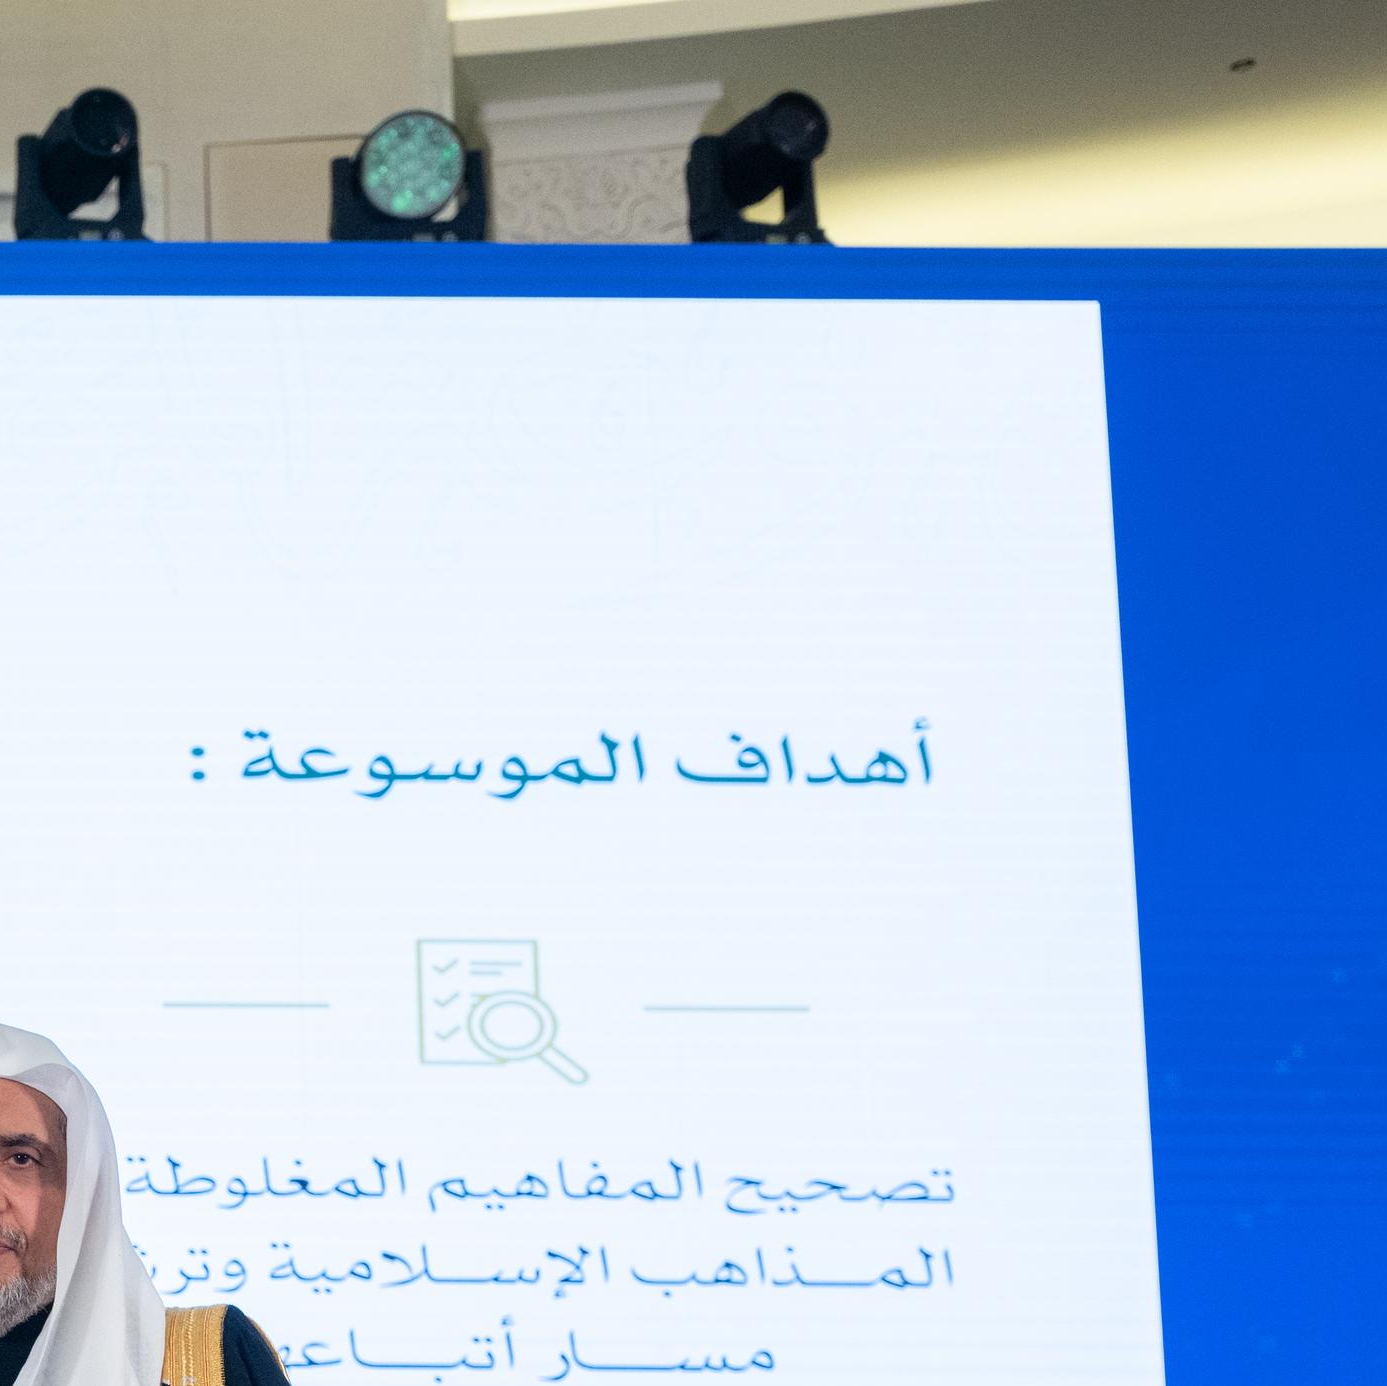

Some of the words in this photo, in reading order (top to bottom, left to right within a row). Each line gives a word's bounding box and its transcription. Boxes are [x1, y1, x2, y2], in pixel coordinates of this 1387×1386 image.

[241, 729, 646, 799] الموسوعة
[675, 716, 934, 787] أهداف
[125, 1155, 405, 1210] المغلوطة
[428, 1159, 705, 1212] المفاهيم
[724, 1165, 957, 1214] تصحيح
